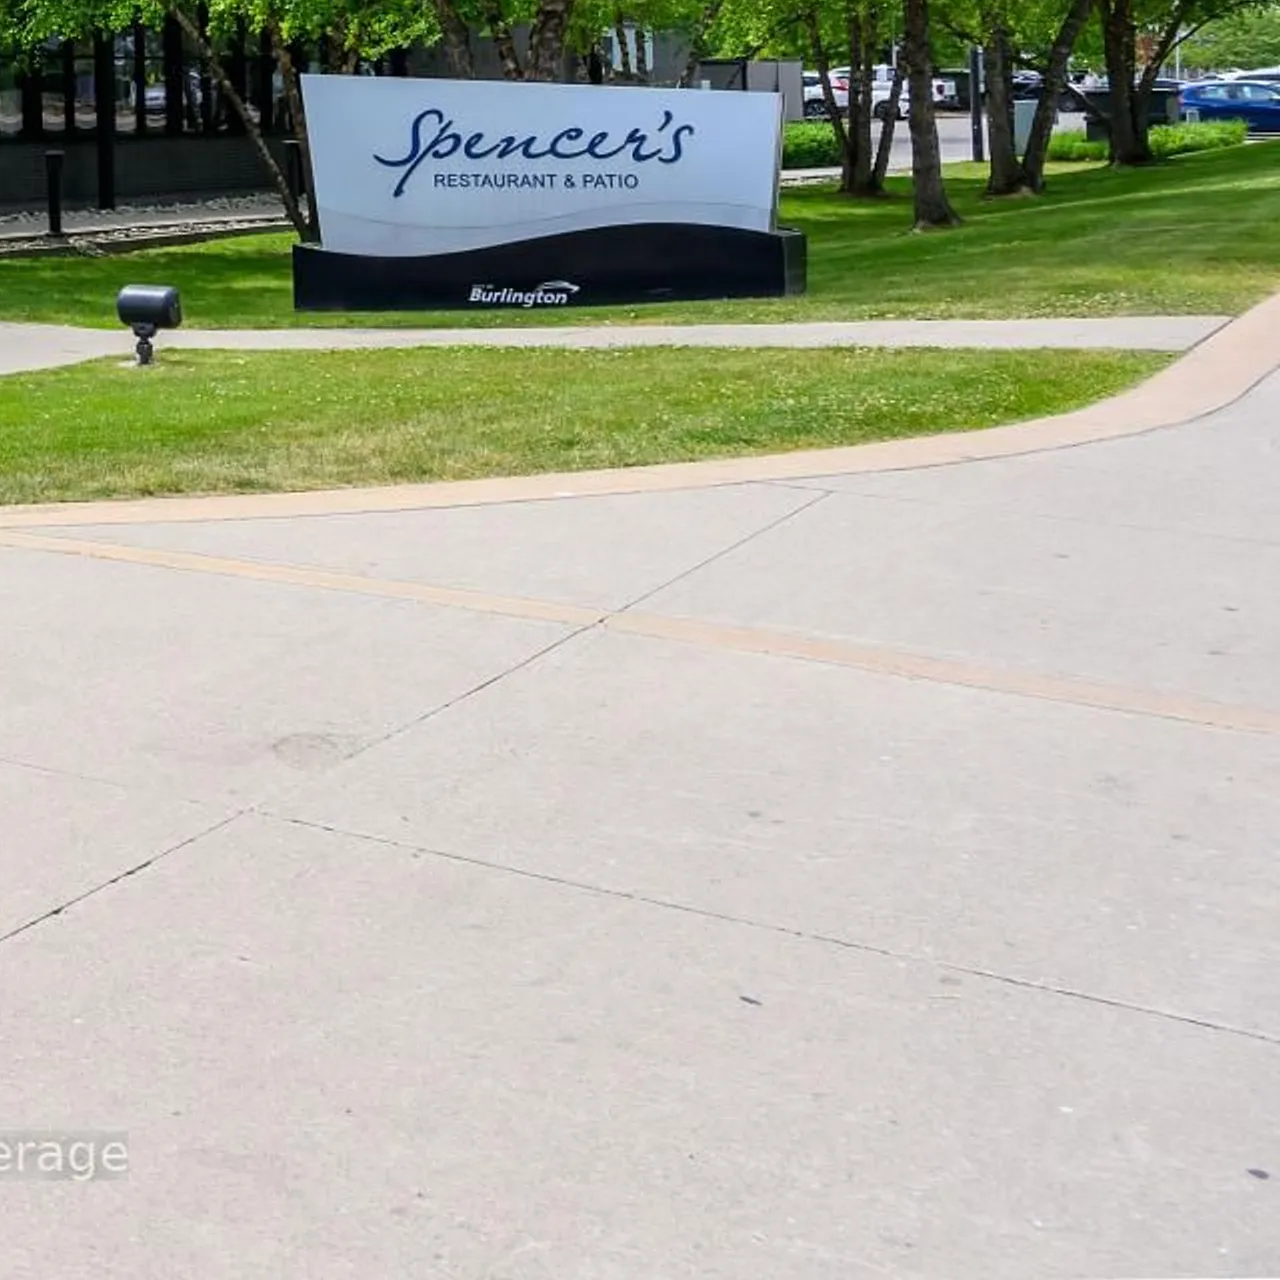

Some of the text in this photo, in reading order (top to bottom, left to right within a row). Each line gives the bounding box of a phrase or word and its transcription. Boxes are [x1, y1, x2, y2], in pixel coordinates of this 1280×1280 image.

[373, 108, 694, 198] Spencer's
[434, 173, 639, 189] RESTAURANT & PATIO
[469, 287, 568, 308] Burlington
